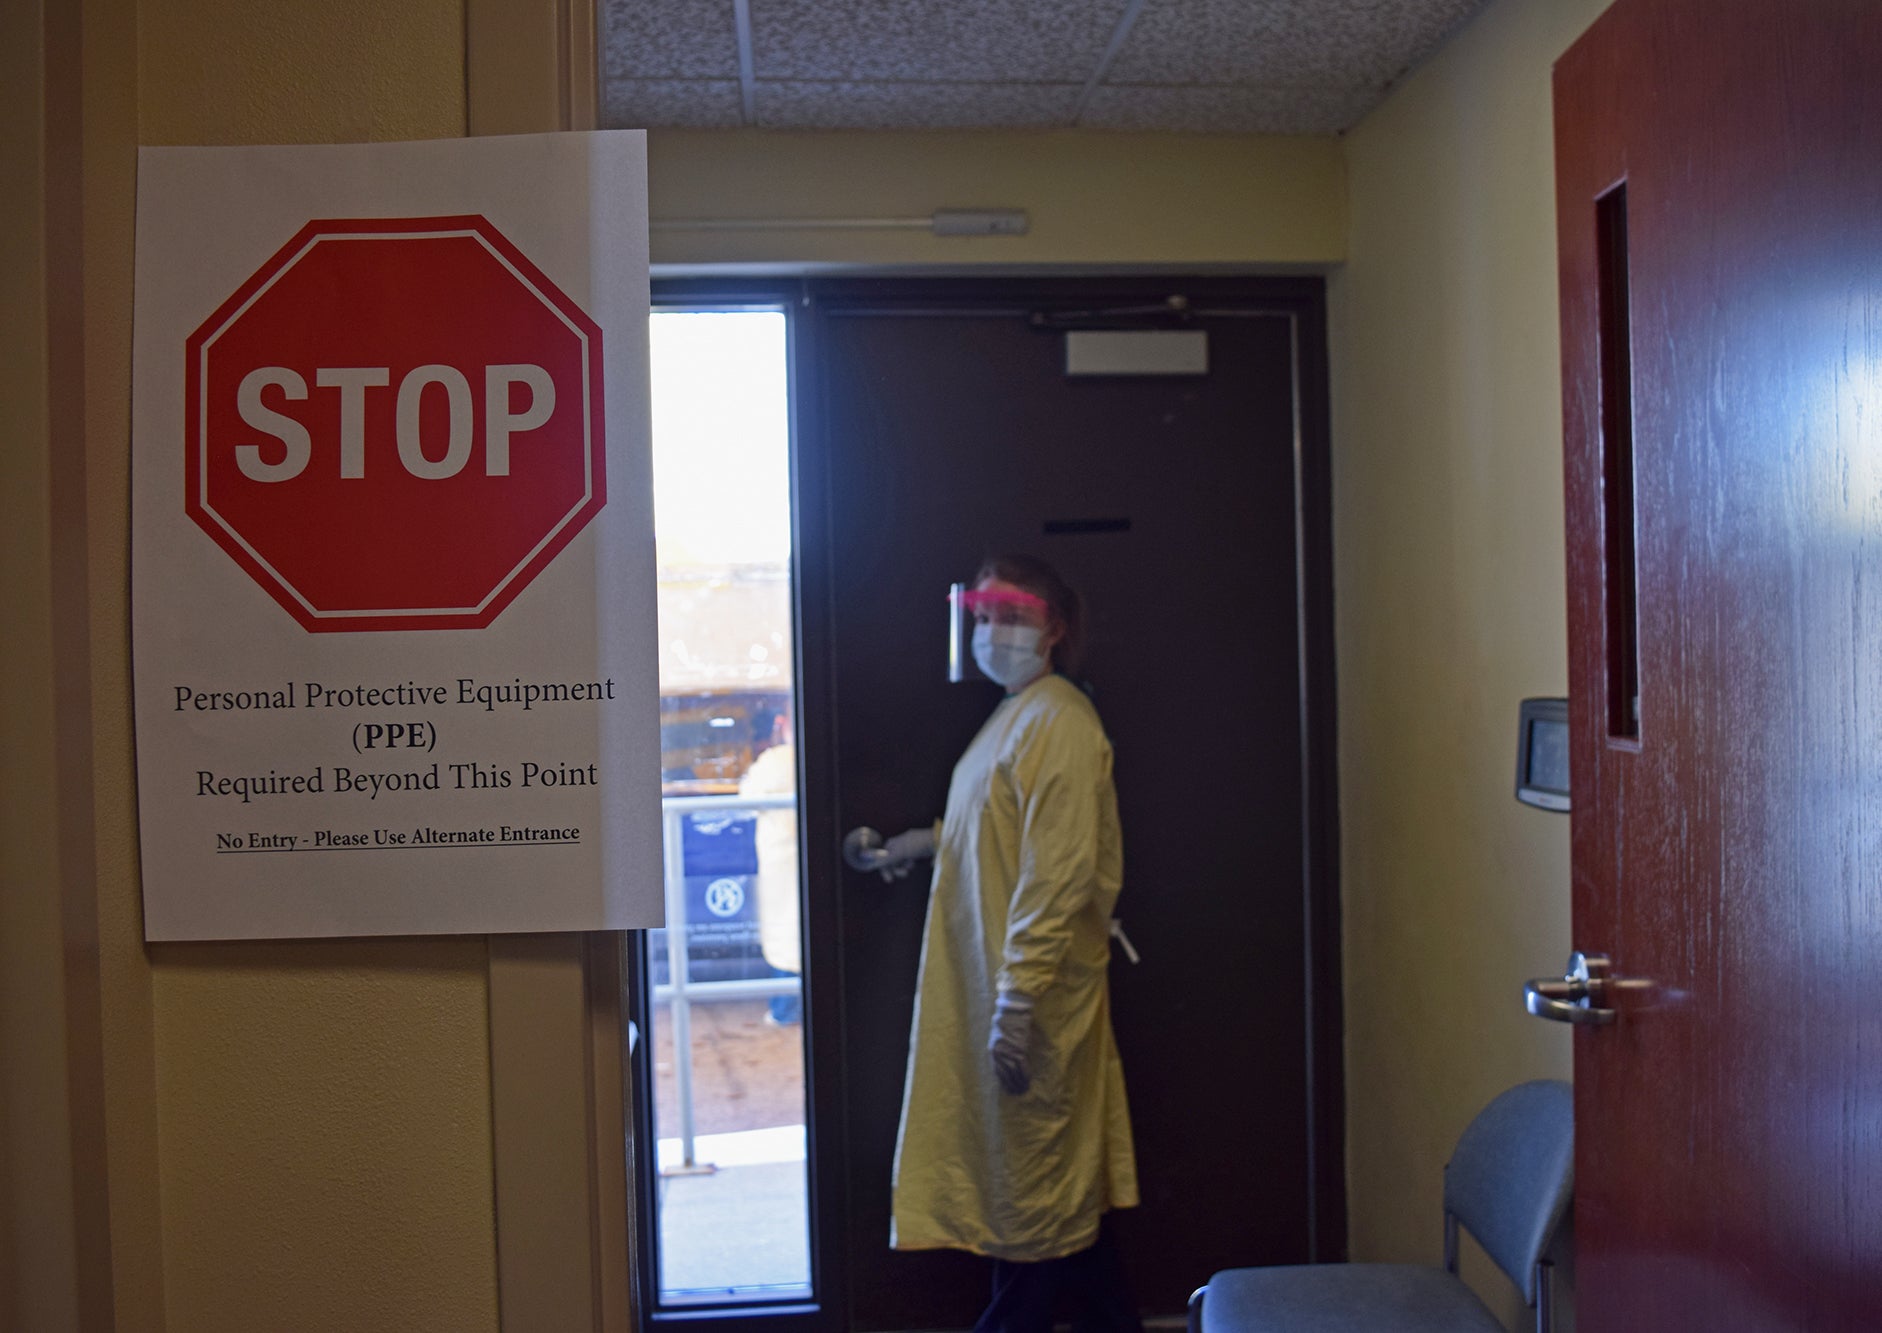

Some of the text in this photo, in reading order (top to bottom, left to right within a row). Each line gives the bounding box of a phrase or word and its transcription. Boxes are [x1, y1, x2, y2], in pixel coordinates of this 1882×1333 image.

[235, 364, 556, 483] STOP
[173, 677, 616, 712] Personal Protective Equipment
[352, 720, 437, 755] (PPE)
[195, 761, 599, 804] Required Beyond This Point
[215, 833, 244, 849] No
[247, 832, 300, 852] Entry
[314, 829, 369, 847] Please
[373, 829, 407, 846] Use
[410, 827, 495, 845] Alternate
[499, 825, 580, 842] Entrance
